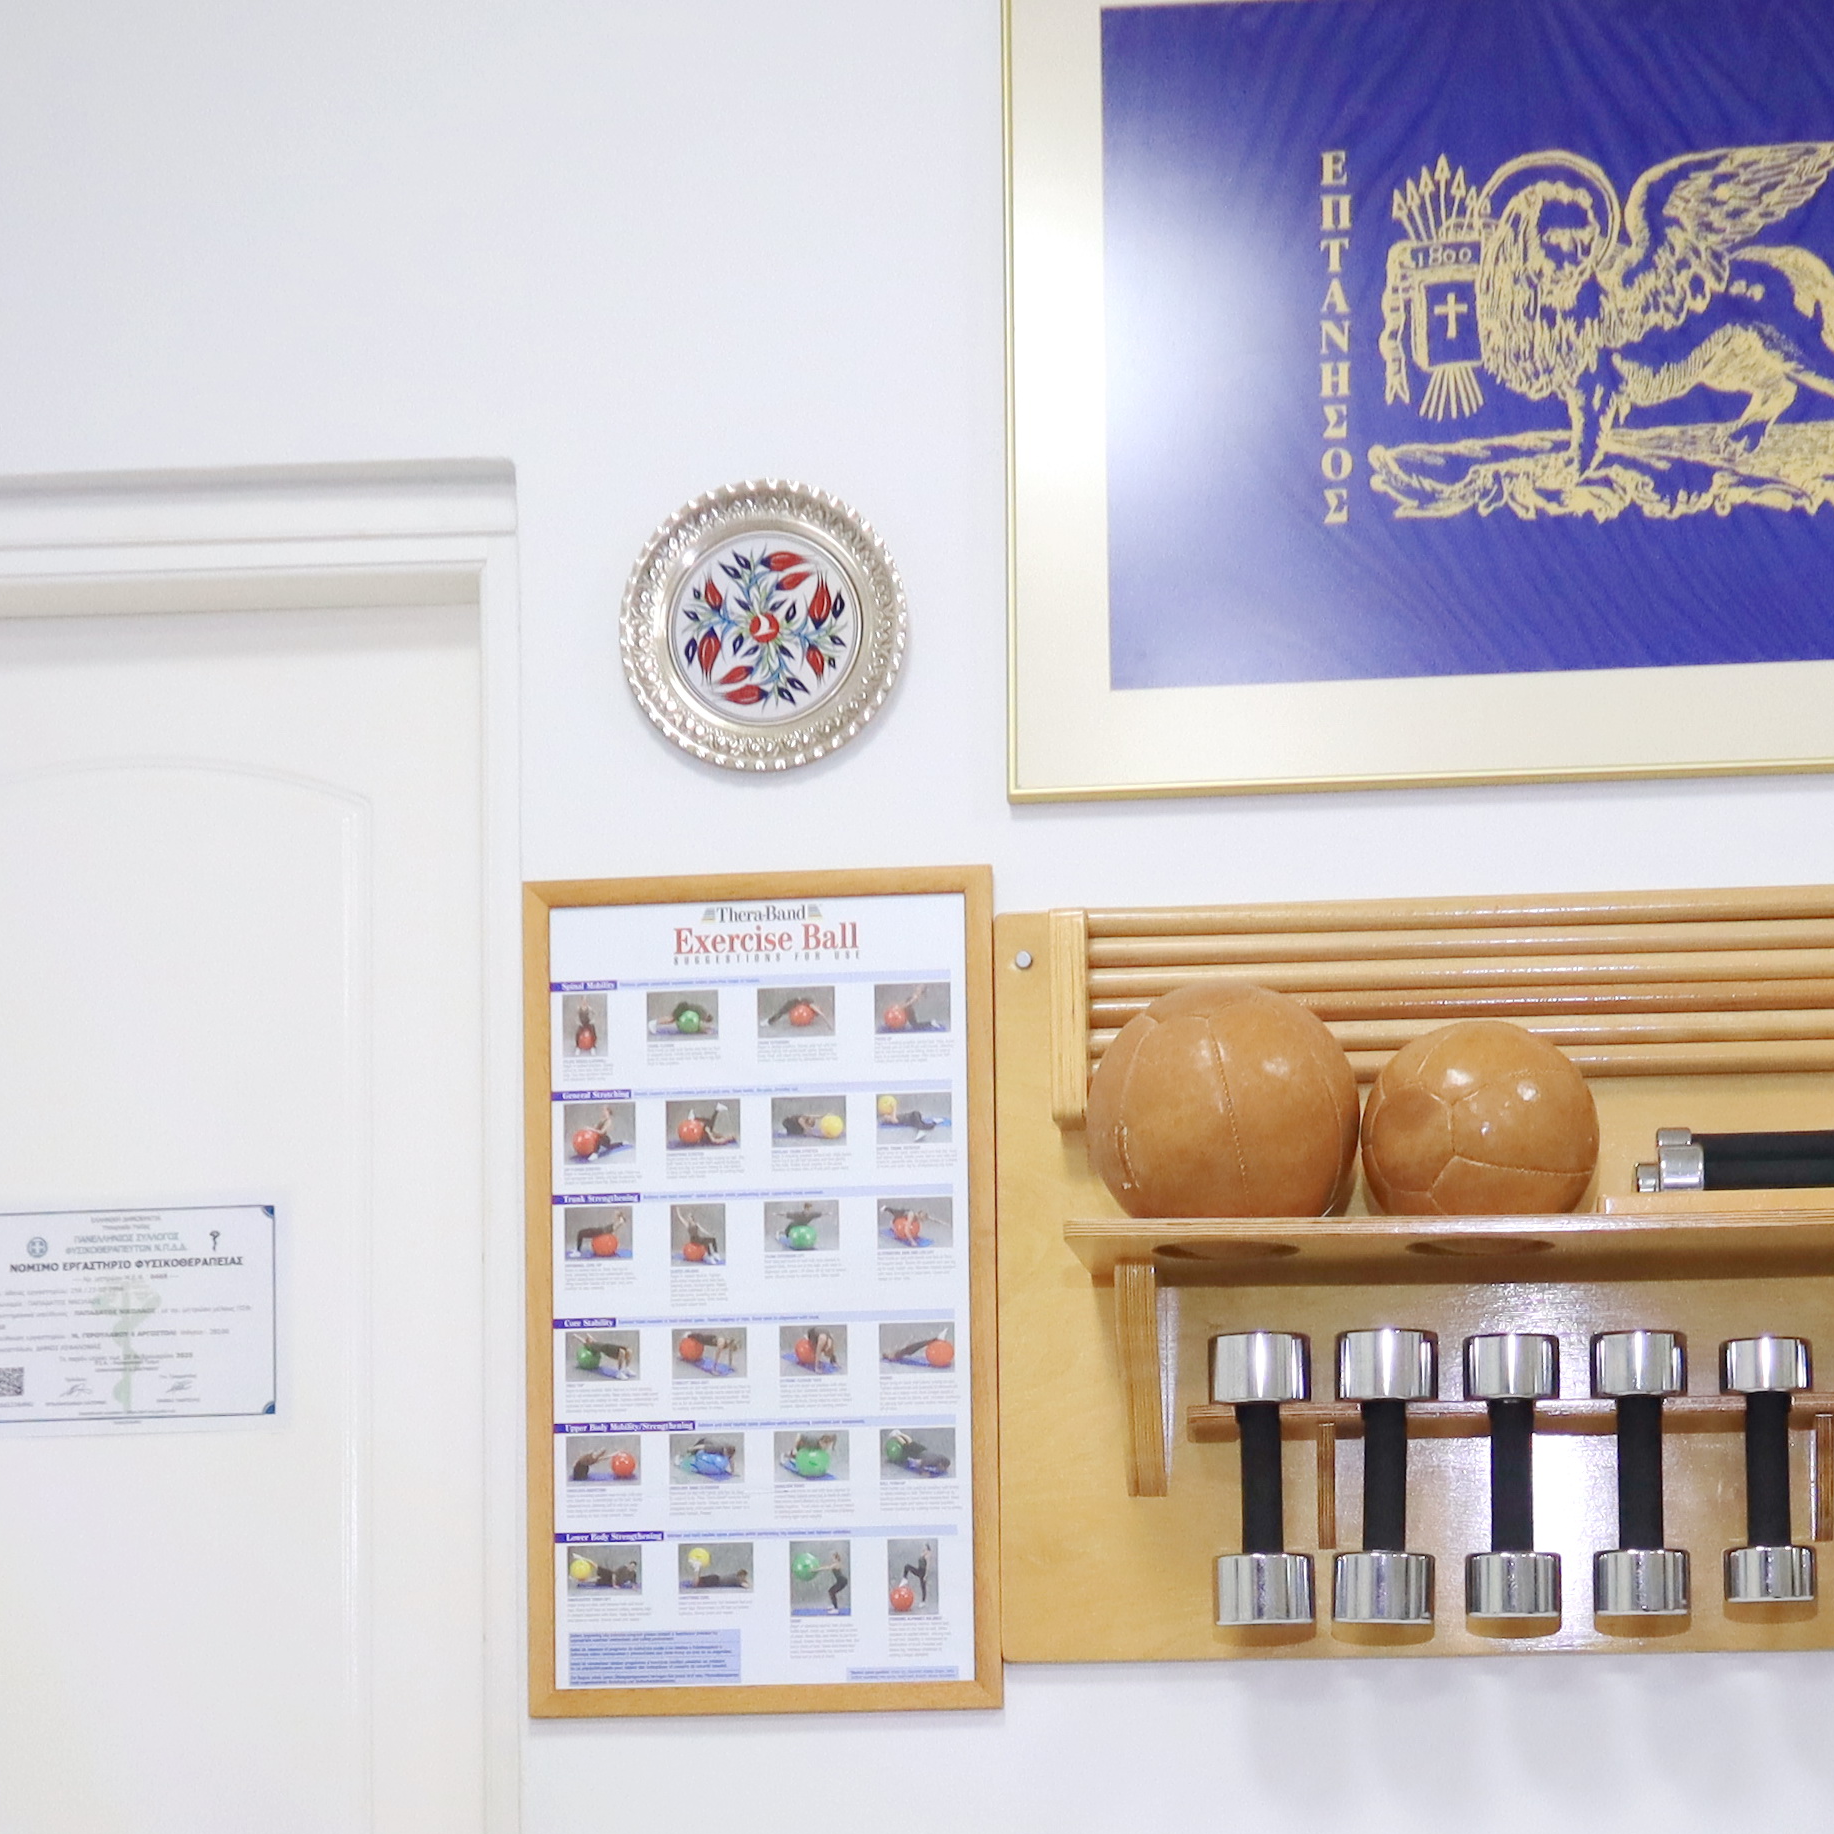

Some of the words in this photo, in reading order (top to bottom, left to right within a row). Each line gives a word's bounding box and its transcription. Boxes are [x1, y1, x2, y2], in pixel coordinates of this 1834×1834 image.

[1417, 246, 1472, 268] 1800
[1319, 149, 1354, 525] ΕΠΤΑΝΗΣΟΣ
[716, 903, 806, 924] Thera-Band
[673, 925, 793, 956] Exercise
[801, 921, 859, 951] Ball
[673, 952, 781, 966] SUGGESTIONS
[794, 951, 821, 962] FOR
[834, 950, 860, 961] USE
[562, 1091, 589, 1100] General
[9, 1262, 59, 1273] ΝΟΜΙΜΟ
[63, 1259, 132, 1271] ΕΡΓΑΣΤΗΡΙΟ
[135, 1256, 244, 1269] ΦΥΣΙΚΟΘΕΡΑΠΕΙΑΣ
[583, 1318, 613, 1328] Stability
[565, 1424, 588, 1433] Upper
[589, 1422, 608, 1433] Body
[566, 1533, 588, 1542] Lower
[589, 1532, 609, 1542] Body
